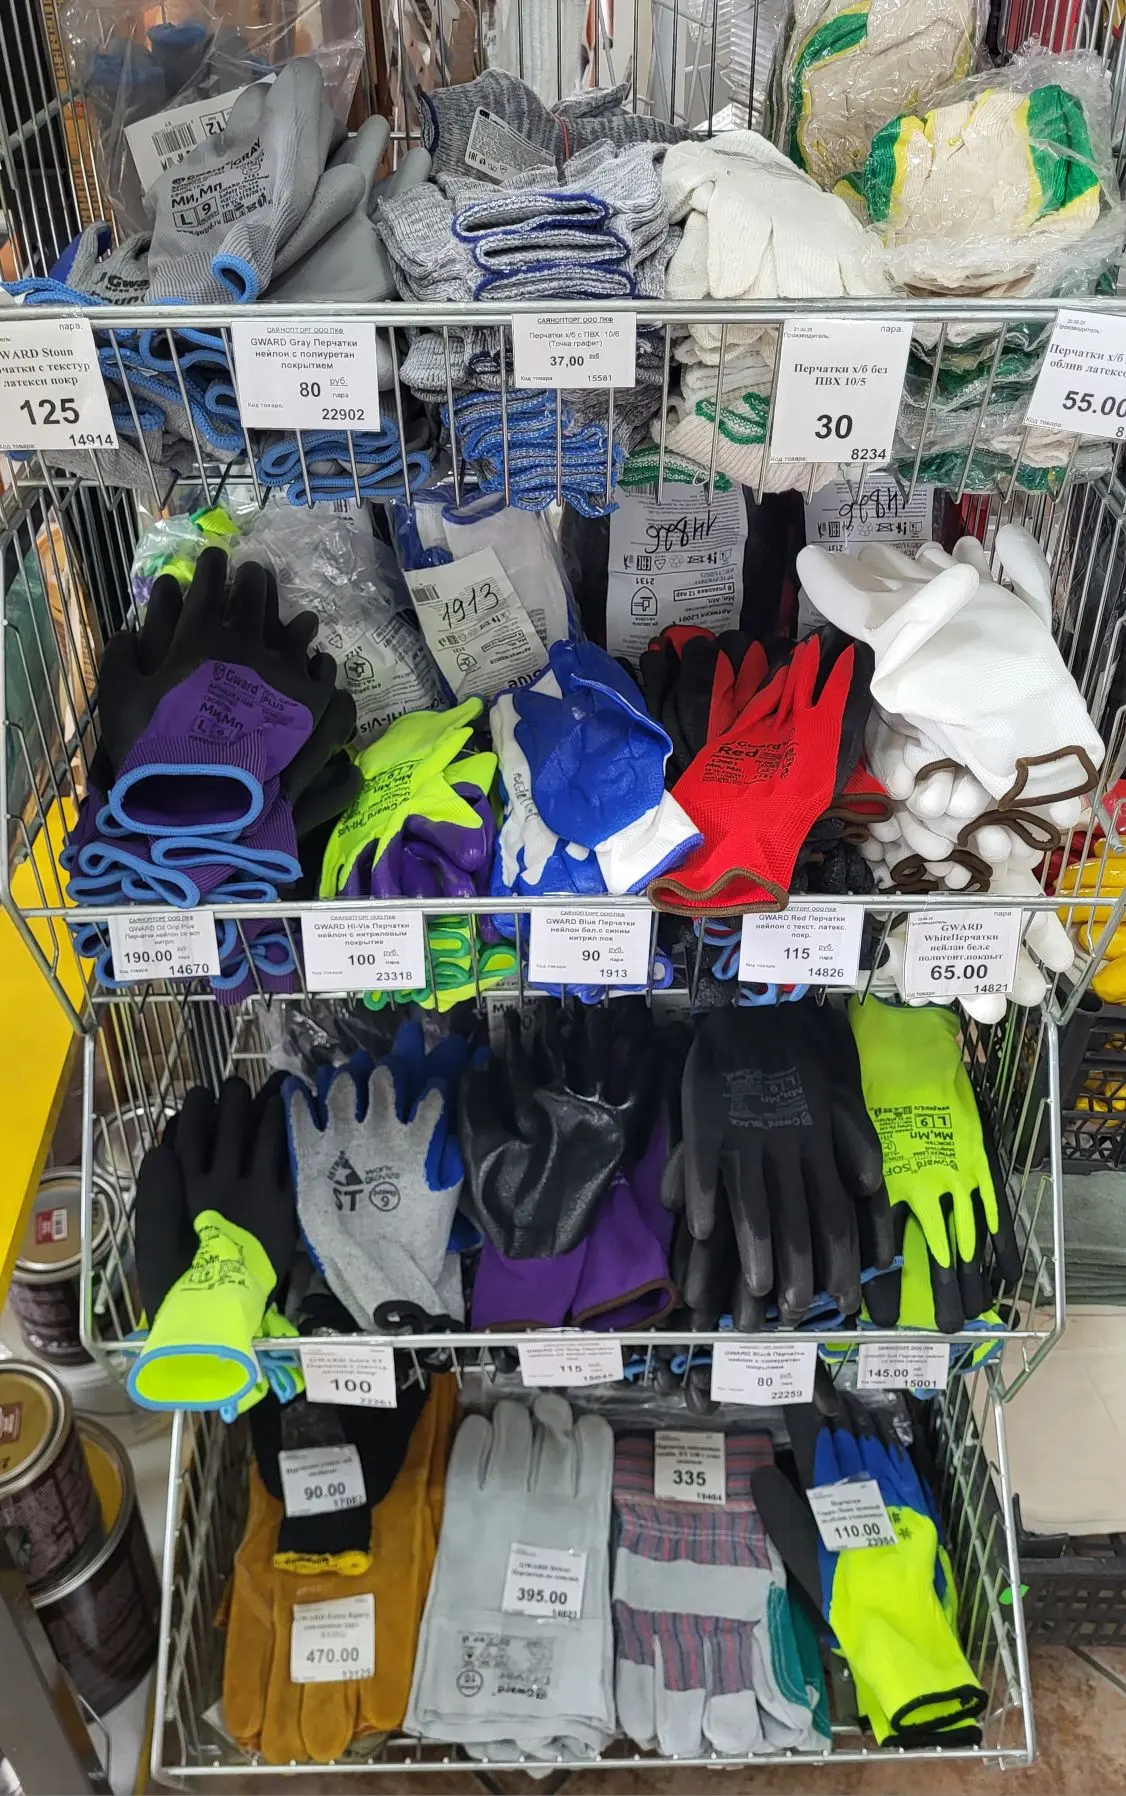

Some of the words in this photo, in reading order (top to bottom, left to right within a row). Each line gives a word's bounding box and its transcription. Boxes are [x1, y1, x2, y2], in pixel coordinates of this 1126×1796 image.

[206, 121, 225, 135] 12
[180, 214, 193, 225] L
[202, 203, 212, 215] 9
[108, 275, 150, 288] Gwa
[529, 332, 563, 340] Перчатки
[250, 338, 287, 346] GWARD
[289, 339, 311, 348] Gray
[313, 338, 358, 348] Перчатки
[548, 340, 572, 348] (Точка
[573, 340, 603, 348] графит)
[42, 347, 74, 358] Stoun
[255, 349, 290, 358] нейлон
[300, 351, 355, 359] полиуретан
[1050, 343, 1105, 360] Перчатки
[281, 362, 334, 370] покрытием
[550, 356, 584, 368] 37,00
[1050, 359, 1083, 371] облив
[47, 362, 91, 376] текстур
[794, 363, 849, 374] Перчатки
[852, 364, 869, 374] х/б
[871, 364, 888, 374] без
[51, 376, 78, 386] покр
[588, 374, 612, 382] 15581
[815, 376, 841, 386] ПВХ
[845, 376, 867, 387] 10/5
[299, 382, 321, 397] 80
[20, 398, 80, 425] 125
[321, 408, 365, 421] 22902
[815, 414, 853, 439] 30
[69, 434, 114, 446] 14914
[851, 448, 887, 460] 8234
[635, 577, 655, 585] 2131
[443, 583, 499, 629] 1913
[717, 745, 760, 758] Red
[598, 919, 636, 927] Перчатки
[808, 914, 846, 922] Перчатки
[373, 922, 410, 930] Перчатки
[941, 923, 983, 931] GWARD
[124, 950, 172, 963] 190.00
[582, 949, 601, 961] 90
[784, 947, 810, 960] 115
[348, 954, 376, 966] 100
[169, 963, 209, 976] 14670
[599, 969, 628, 978] 1913
[807, 968, 844, 978] 14826
[930, 964, 988, 980] 65.00
[376, 971, 413, 981] 23318
[974, 984, 1008, 993] 14821
[885, 1163, 910, 1177] SOF
[330, 1379, 372, 1393] 100
[757, 1377, 773, 1387] 80
[673, 1469, 706, 1486] 335
[304, 1482, 346, 1500] 90.00
[834, 1523, 880, 1539] 110.00
[517, 1587, 567, 1604] 395.00
[306, 1647, 359, 1663] 470.00
